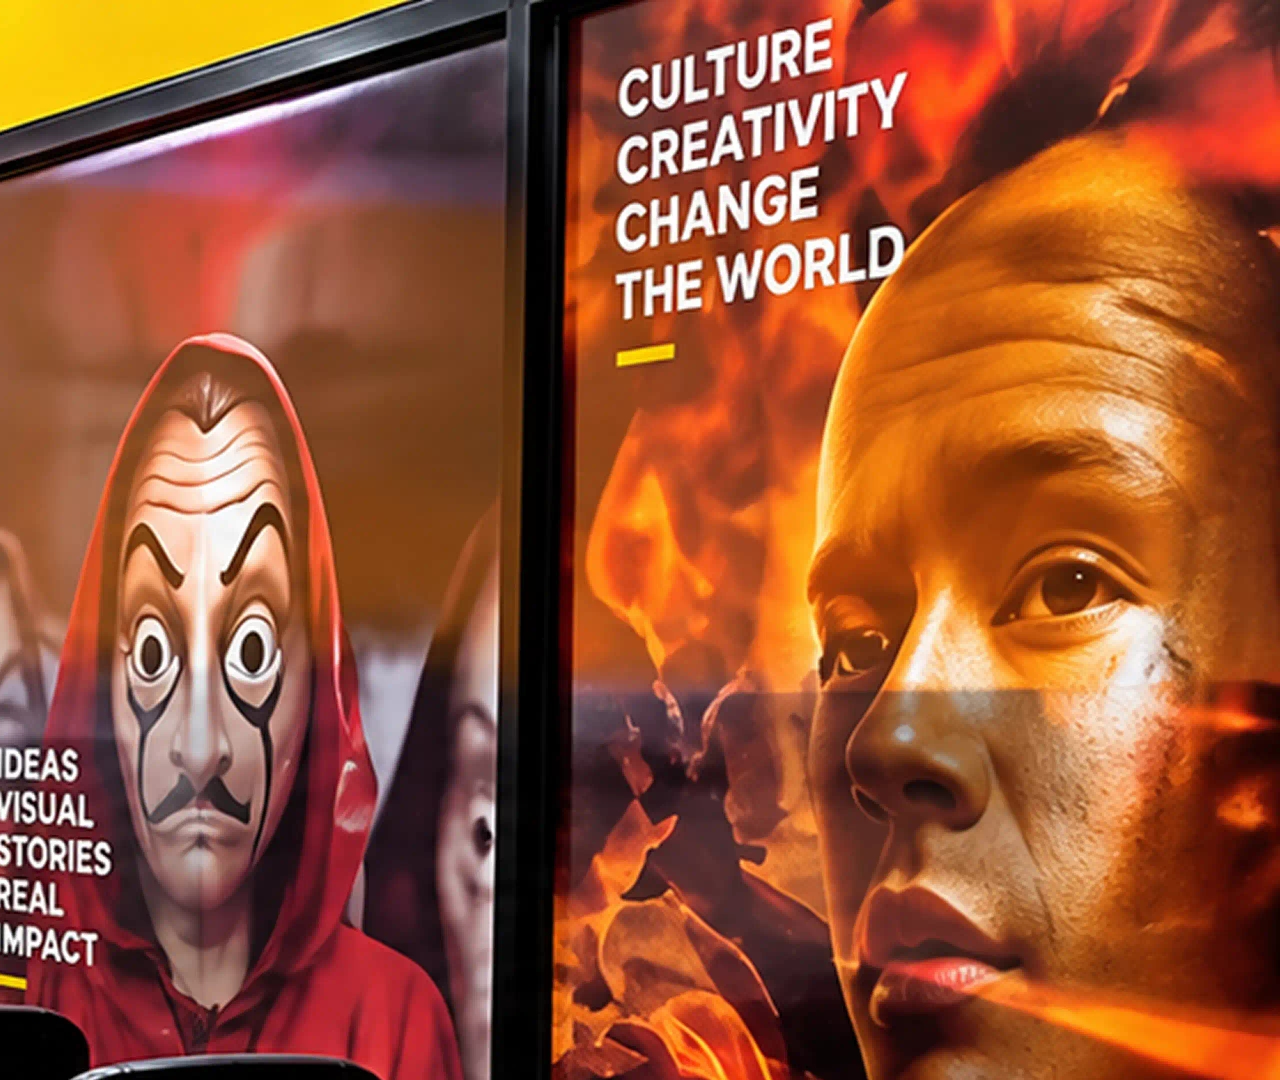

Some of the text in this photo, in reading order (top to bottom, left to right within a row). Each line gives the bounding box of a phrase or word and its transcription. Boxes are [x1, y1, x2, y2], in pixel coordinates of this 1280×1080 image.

[617, 17, 833, 118] CULTURE
[615, 71, 909, 185] CREATIVITY
[614, 166, 821, 253] CHANGE
[615, 225, 907, 320] THE WORLD
